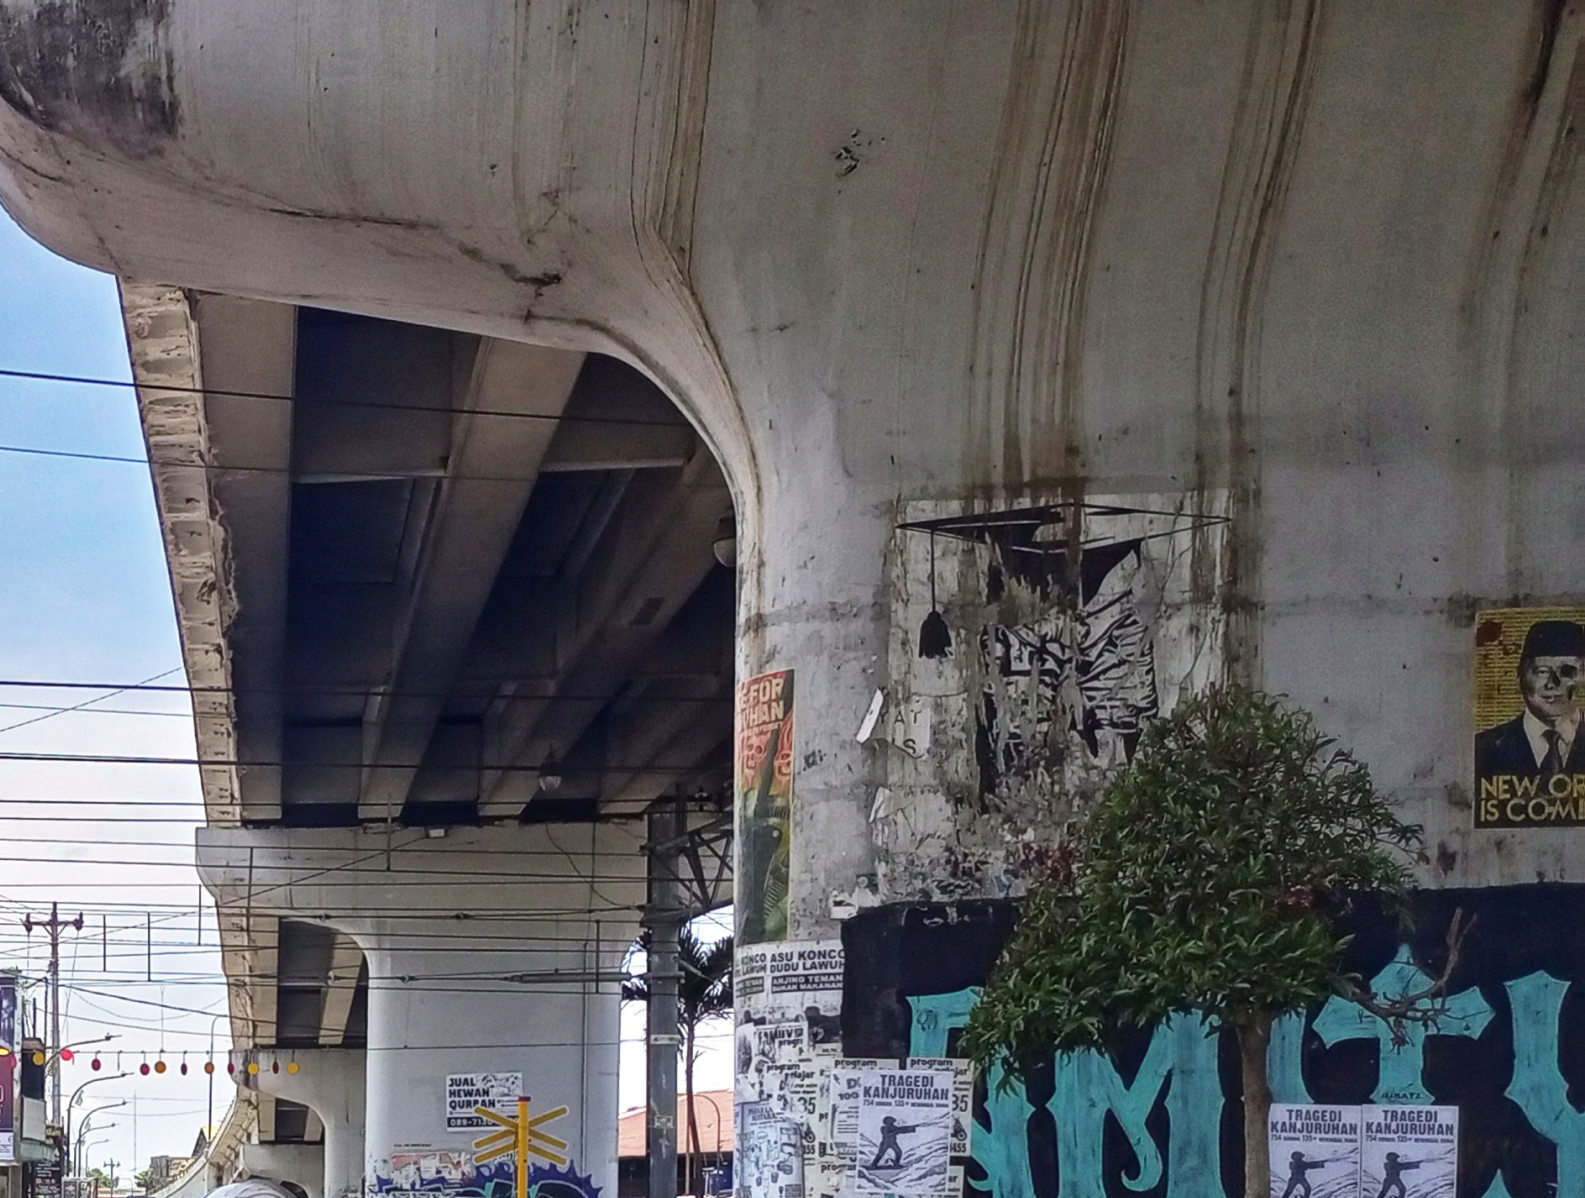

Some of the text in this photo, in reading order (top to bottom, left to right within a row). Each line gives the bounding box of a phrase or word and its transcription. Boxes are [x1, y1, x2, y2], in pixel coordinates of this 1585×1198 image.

[1481, 773, 1585, 799] NEW OR
[1480, 798, 1585, 822] IS COMI
[770, 951, 794, 963] ASU
[770, 962, 799, 974] DUDU
[808, 974, 843, 983] TEMAN
[834, 1060, 877, 1069] program
[910, 1058, 953, 1068] program
[448, 1077, 476, 1088] JUAL
[880, 1074, 934, 1087] TRAGEDI
[448, 1087, 490, 1098] HEWAN
[863, 1087, 949, 1100] KANJURUHAN
[1287, 1109, 1342, 1122] TRAGEDI
[1382, 1110, 1438, 1123] TRAGEDI
[1270, 1121, 1358, 1135] KANJURUHAN
[1365, 1122, 1454, 1136] KANJURUHAN
